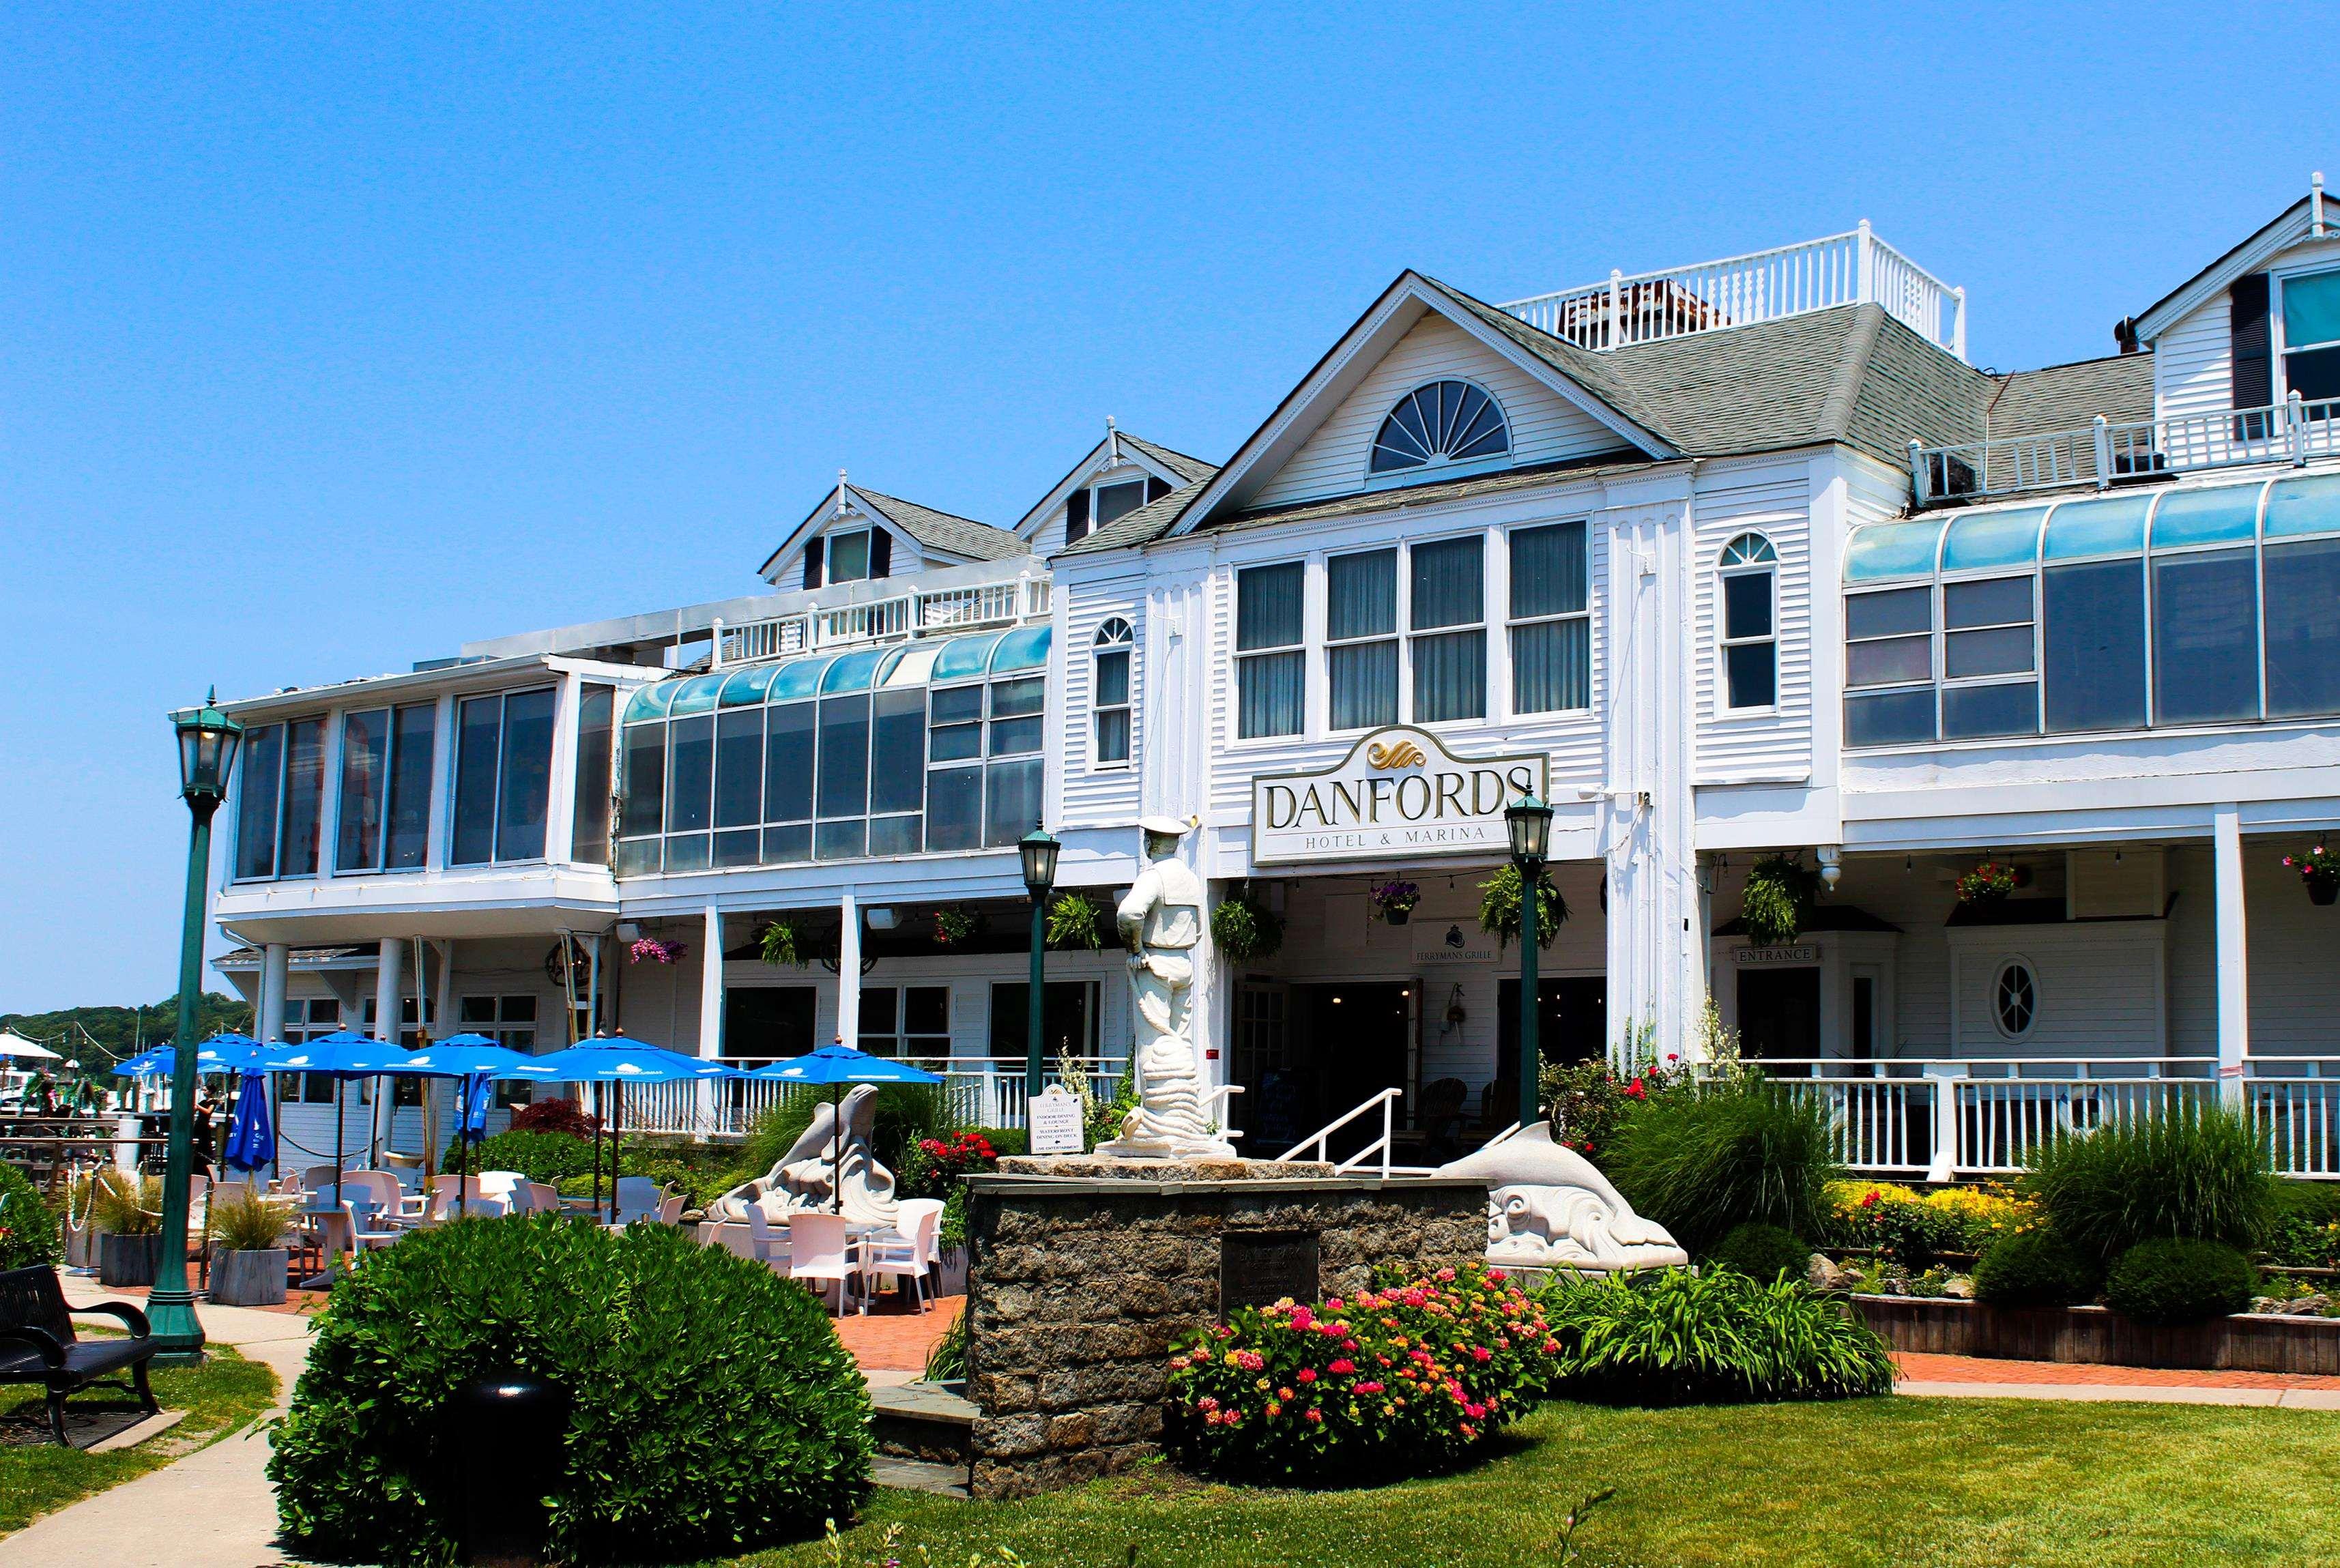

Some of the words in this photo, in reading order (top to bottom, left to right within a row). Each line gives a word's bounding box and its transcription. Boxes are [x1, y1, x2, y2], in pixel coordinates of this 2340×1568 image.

[1263, 767, 1531, 830] DANFORDS
[1305, 834, 1366, 850] HOTEL
[1380, 832, 1391, 845] &
[1404, 826, 1485, 843] MARINA
[1464, 950, 1492, 959] GRILLE
[1740, 948, 1810, 961] ENTRANCE
